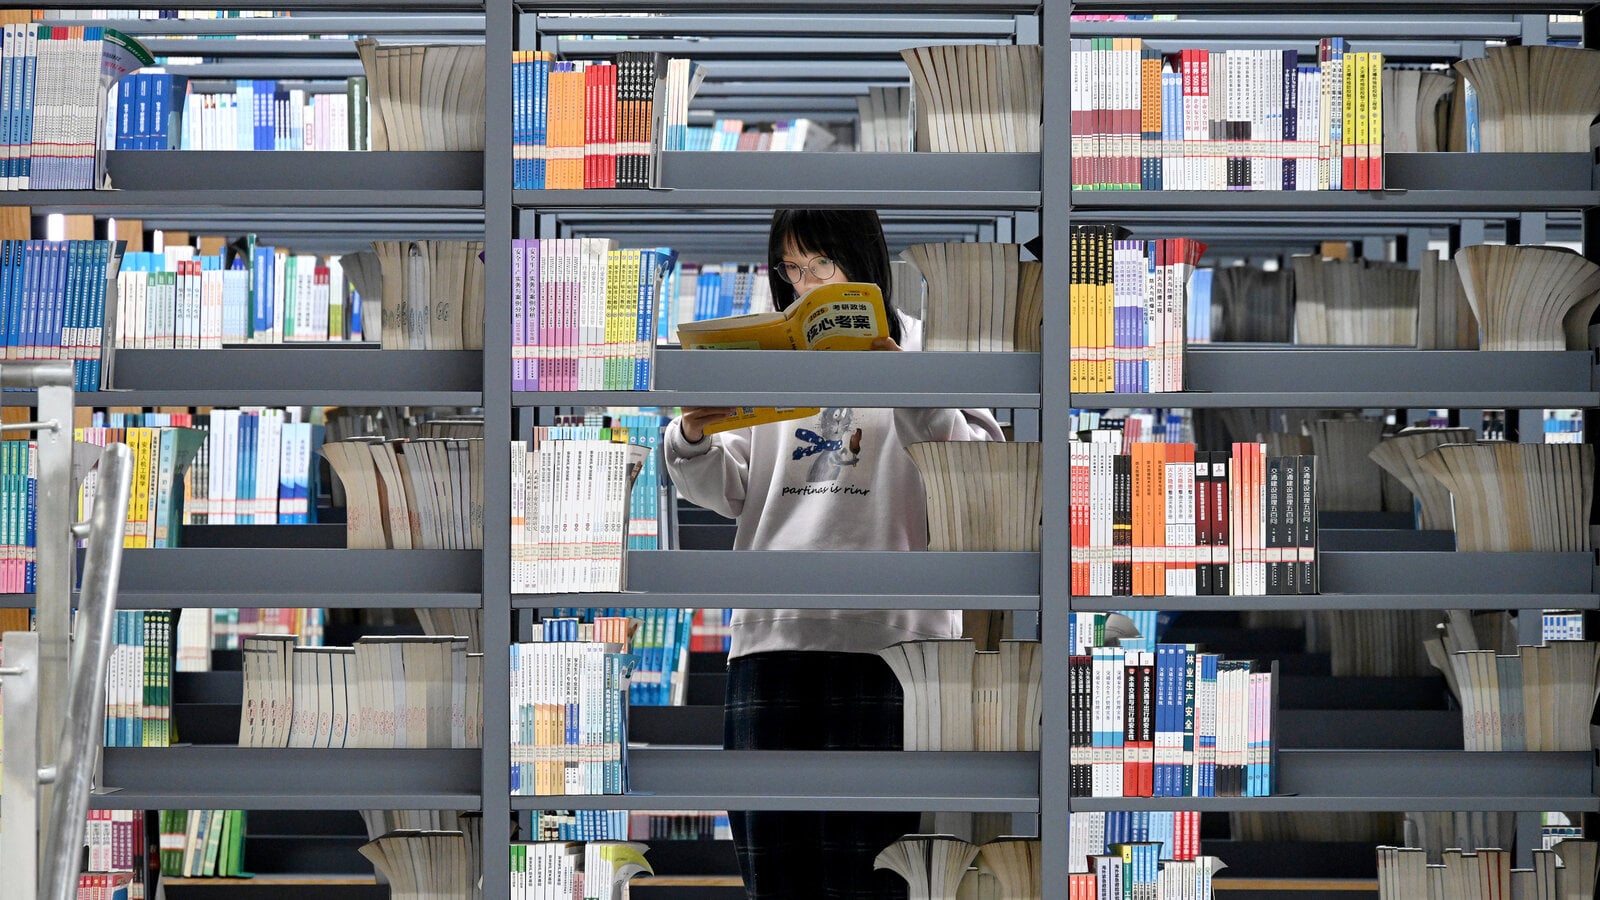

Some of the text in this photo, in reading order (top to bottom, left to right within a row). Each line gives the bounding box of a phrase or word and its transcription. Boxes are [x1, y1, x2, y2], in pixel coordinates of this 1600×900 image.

[808, 308, 825, 322] 2025
[807, 315, 871, 343] 核心考案
[830, 483, 841, 493] is
[1185, 654, 1194, 730] 林业生产安全
